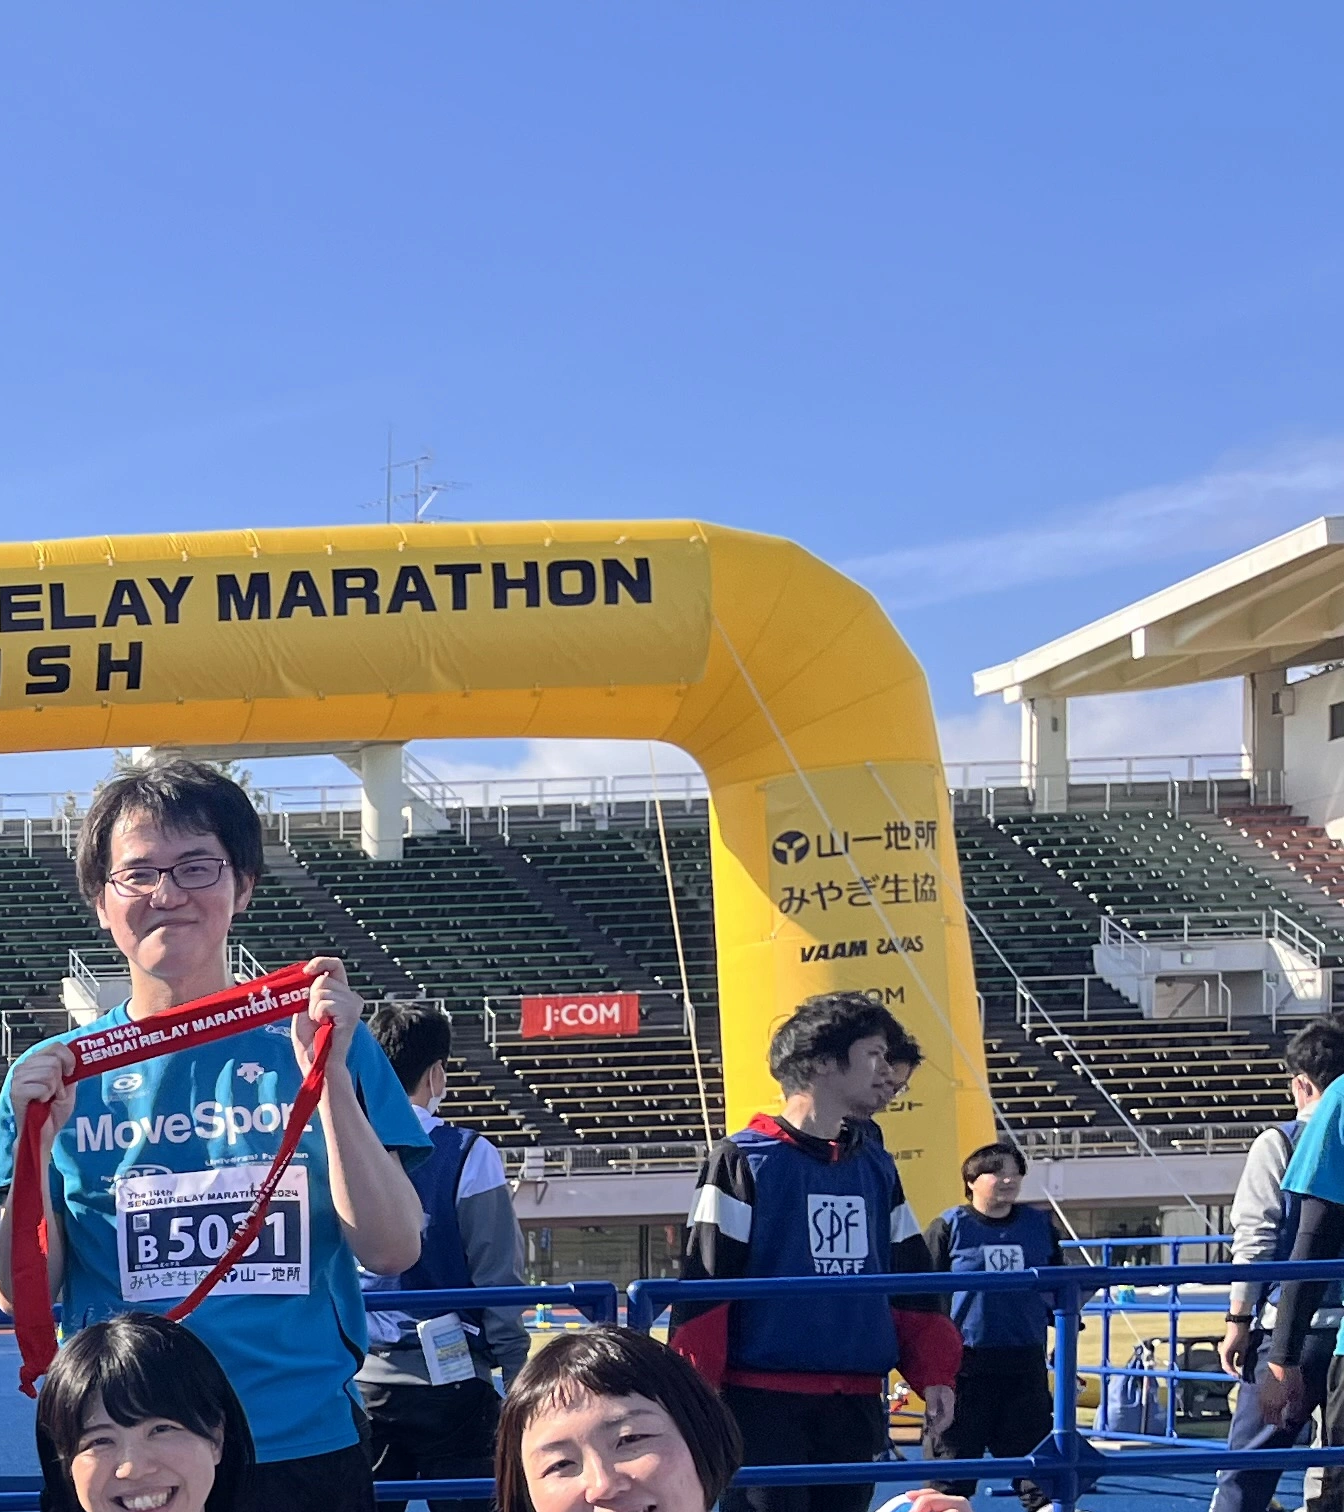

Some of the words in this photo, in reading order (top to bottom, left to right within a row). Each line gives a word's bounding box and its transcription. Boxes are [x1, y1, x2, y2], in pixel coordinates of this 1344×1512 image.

[216, 557, 652, 622] MARATHON
[817, 821, 937, 857] 山一地所
[779, 873, 936, 914] みやぎ生協
[800, 940, 867, 962] VAAM
[81, 1039, 138, 1066] SENDAI
[140, 1024, 190, 1048] RELAY
[192, 999, 278, 1033] MARATHON
[280, 987, 310, 1006] 202
[543, 1002, 620, 1031] J:COM
[77, 1038, 106, 1052] The
[106, 1026, 142, 1043] 14th
[76, 1101, 313, 1152] MoveSpor
[127, 1198, 167, 1208] SENDAI
[168, 1193, 205, 1205] RELAY
[207, 1188, 267, 1201] MARATHO
[137, 1235, 159, 1263] B
[241, 1266, 301, 1282] 山一地所
[814, 1259, 865, 1274] STAFF
